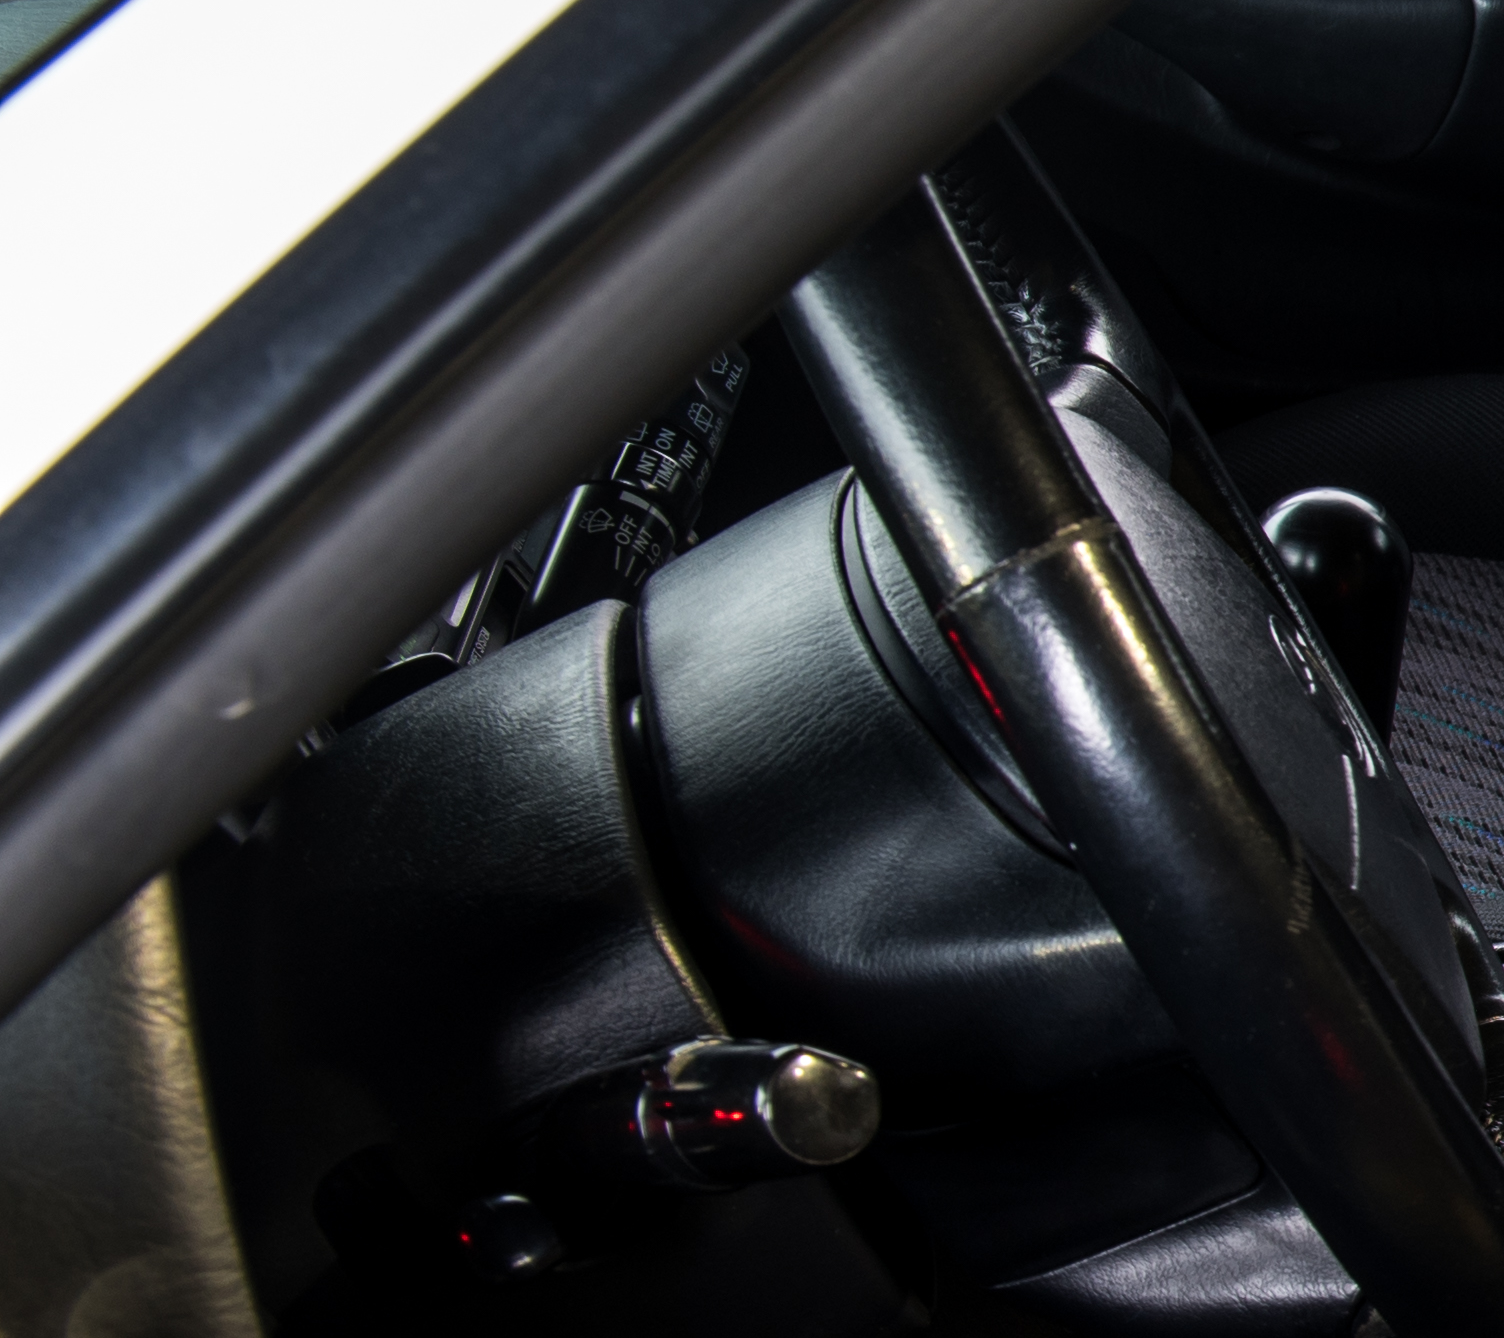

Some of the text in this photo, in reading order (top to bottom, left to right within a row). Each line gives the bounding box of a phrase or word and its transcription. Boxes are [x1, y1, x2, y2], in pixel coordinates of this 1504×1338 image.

[725, 364, 744, 393] PULL
[655, 427, 678, 452] ON
[708, 417, 725, 449] REAR
[635, 451, 659, 476] INT
[679, 439, 699, 469] INT
[652, 458, 679, 489] TIME
[696, 460, 711, 490] OFF
[615, 514, 639, 546] OFF
[632, 526, 654, 555] INT
[646, 543, 662, 565] LO
